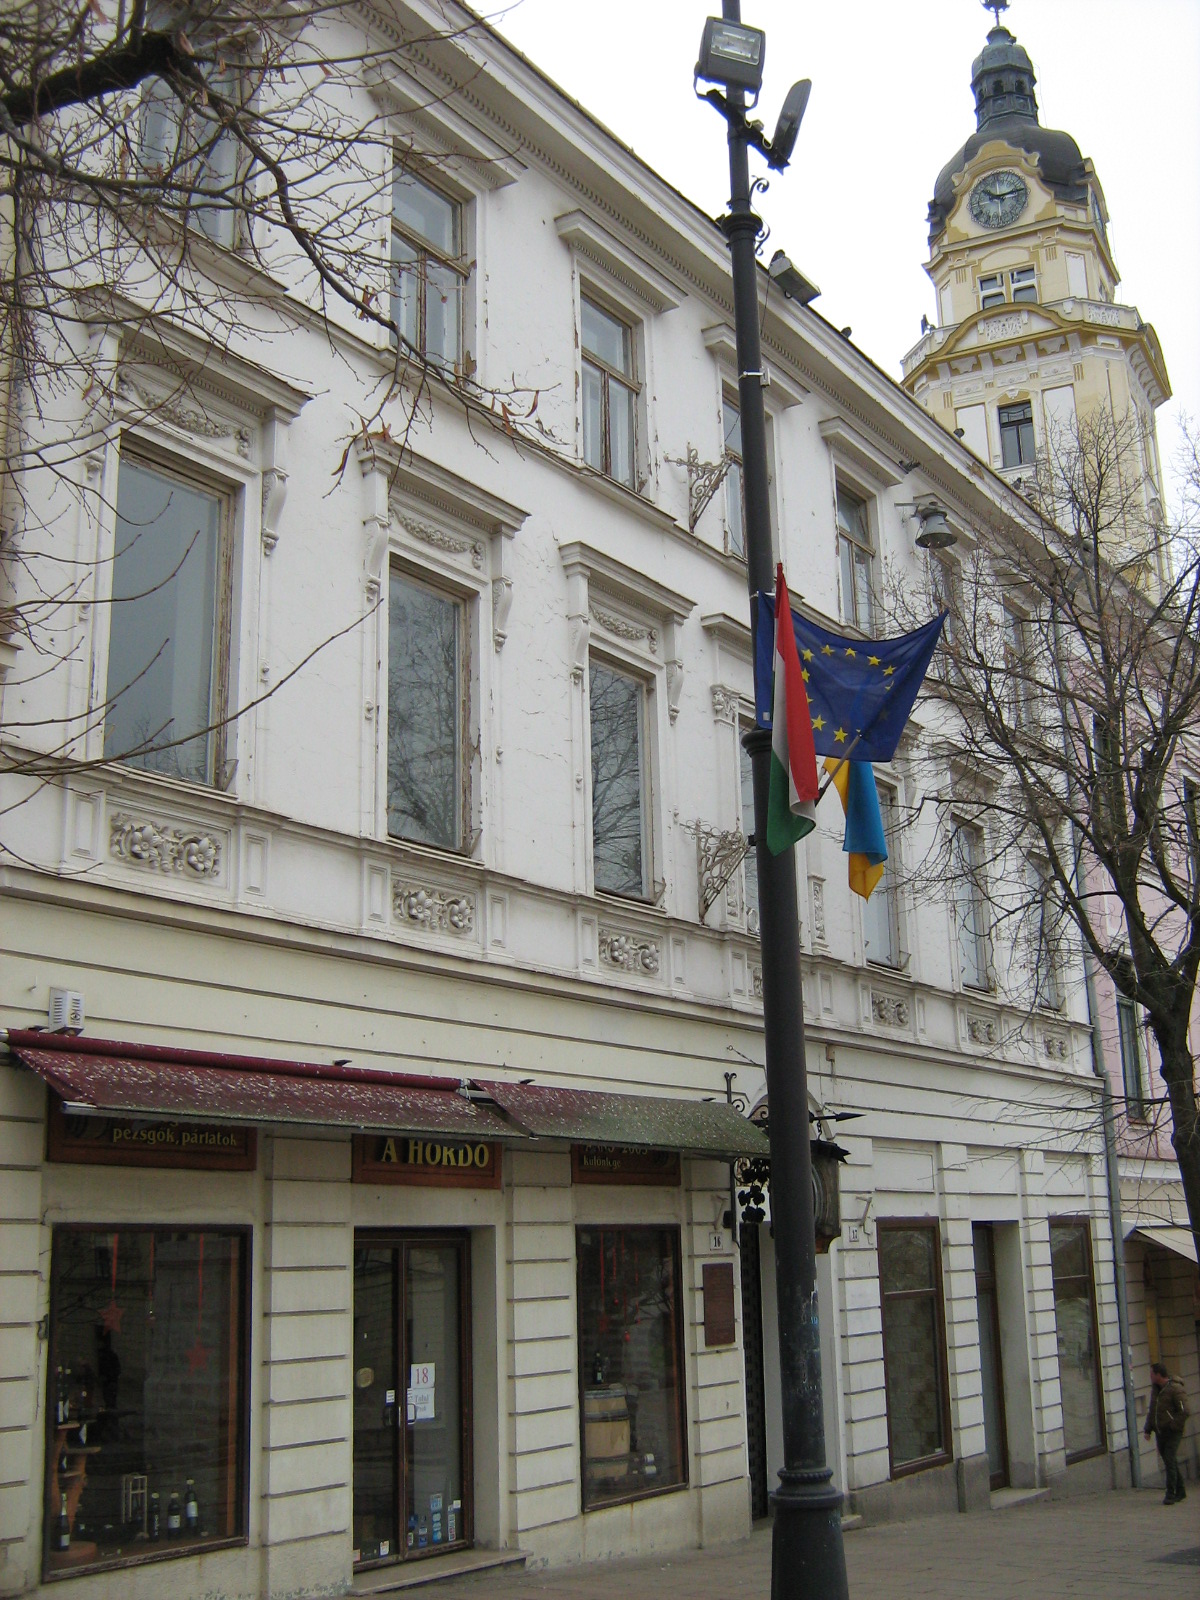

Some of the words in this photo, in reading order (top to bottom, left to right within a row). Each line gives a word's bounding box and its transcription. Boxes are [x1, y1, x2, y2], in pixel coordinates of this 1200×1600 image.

[182, 1129, 237, 1146] párlatok
[381, 1138, 398, 1162] A
[714, 1236, 721, 1248] 16
[416, 1367, 429, 1385] 18
